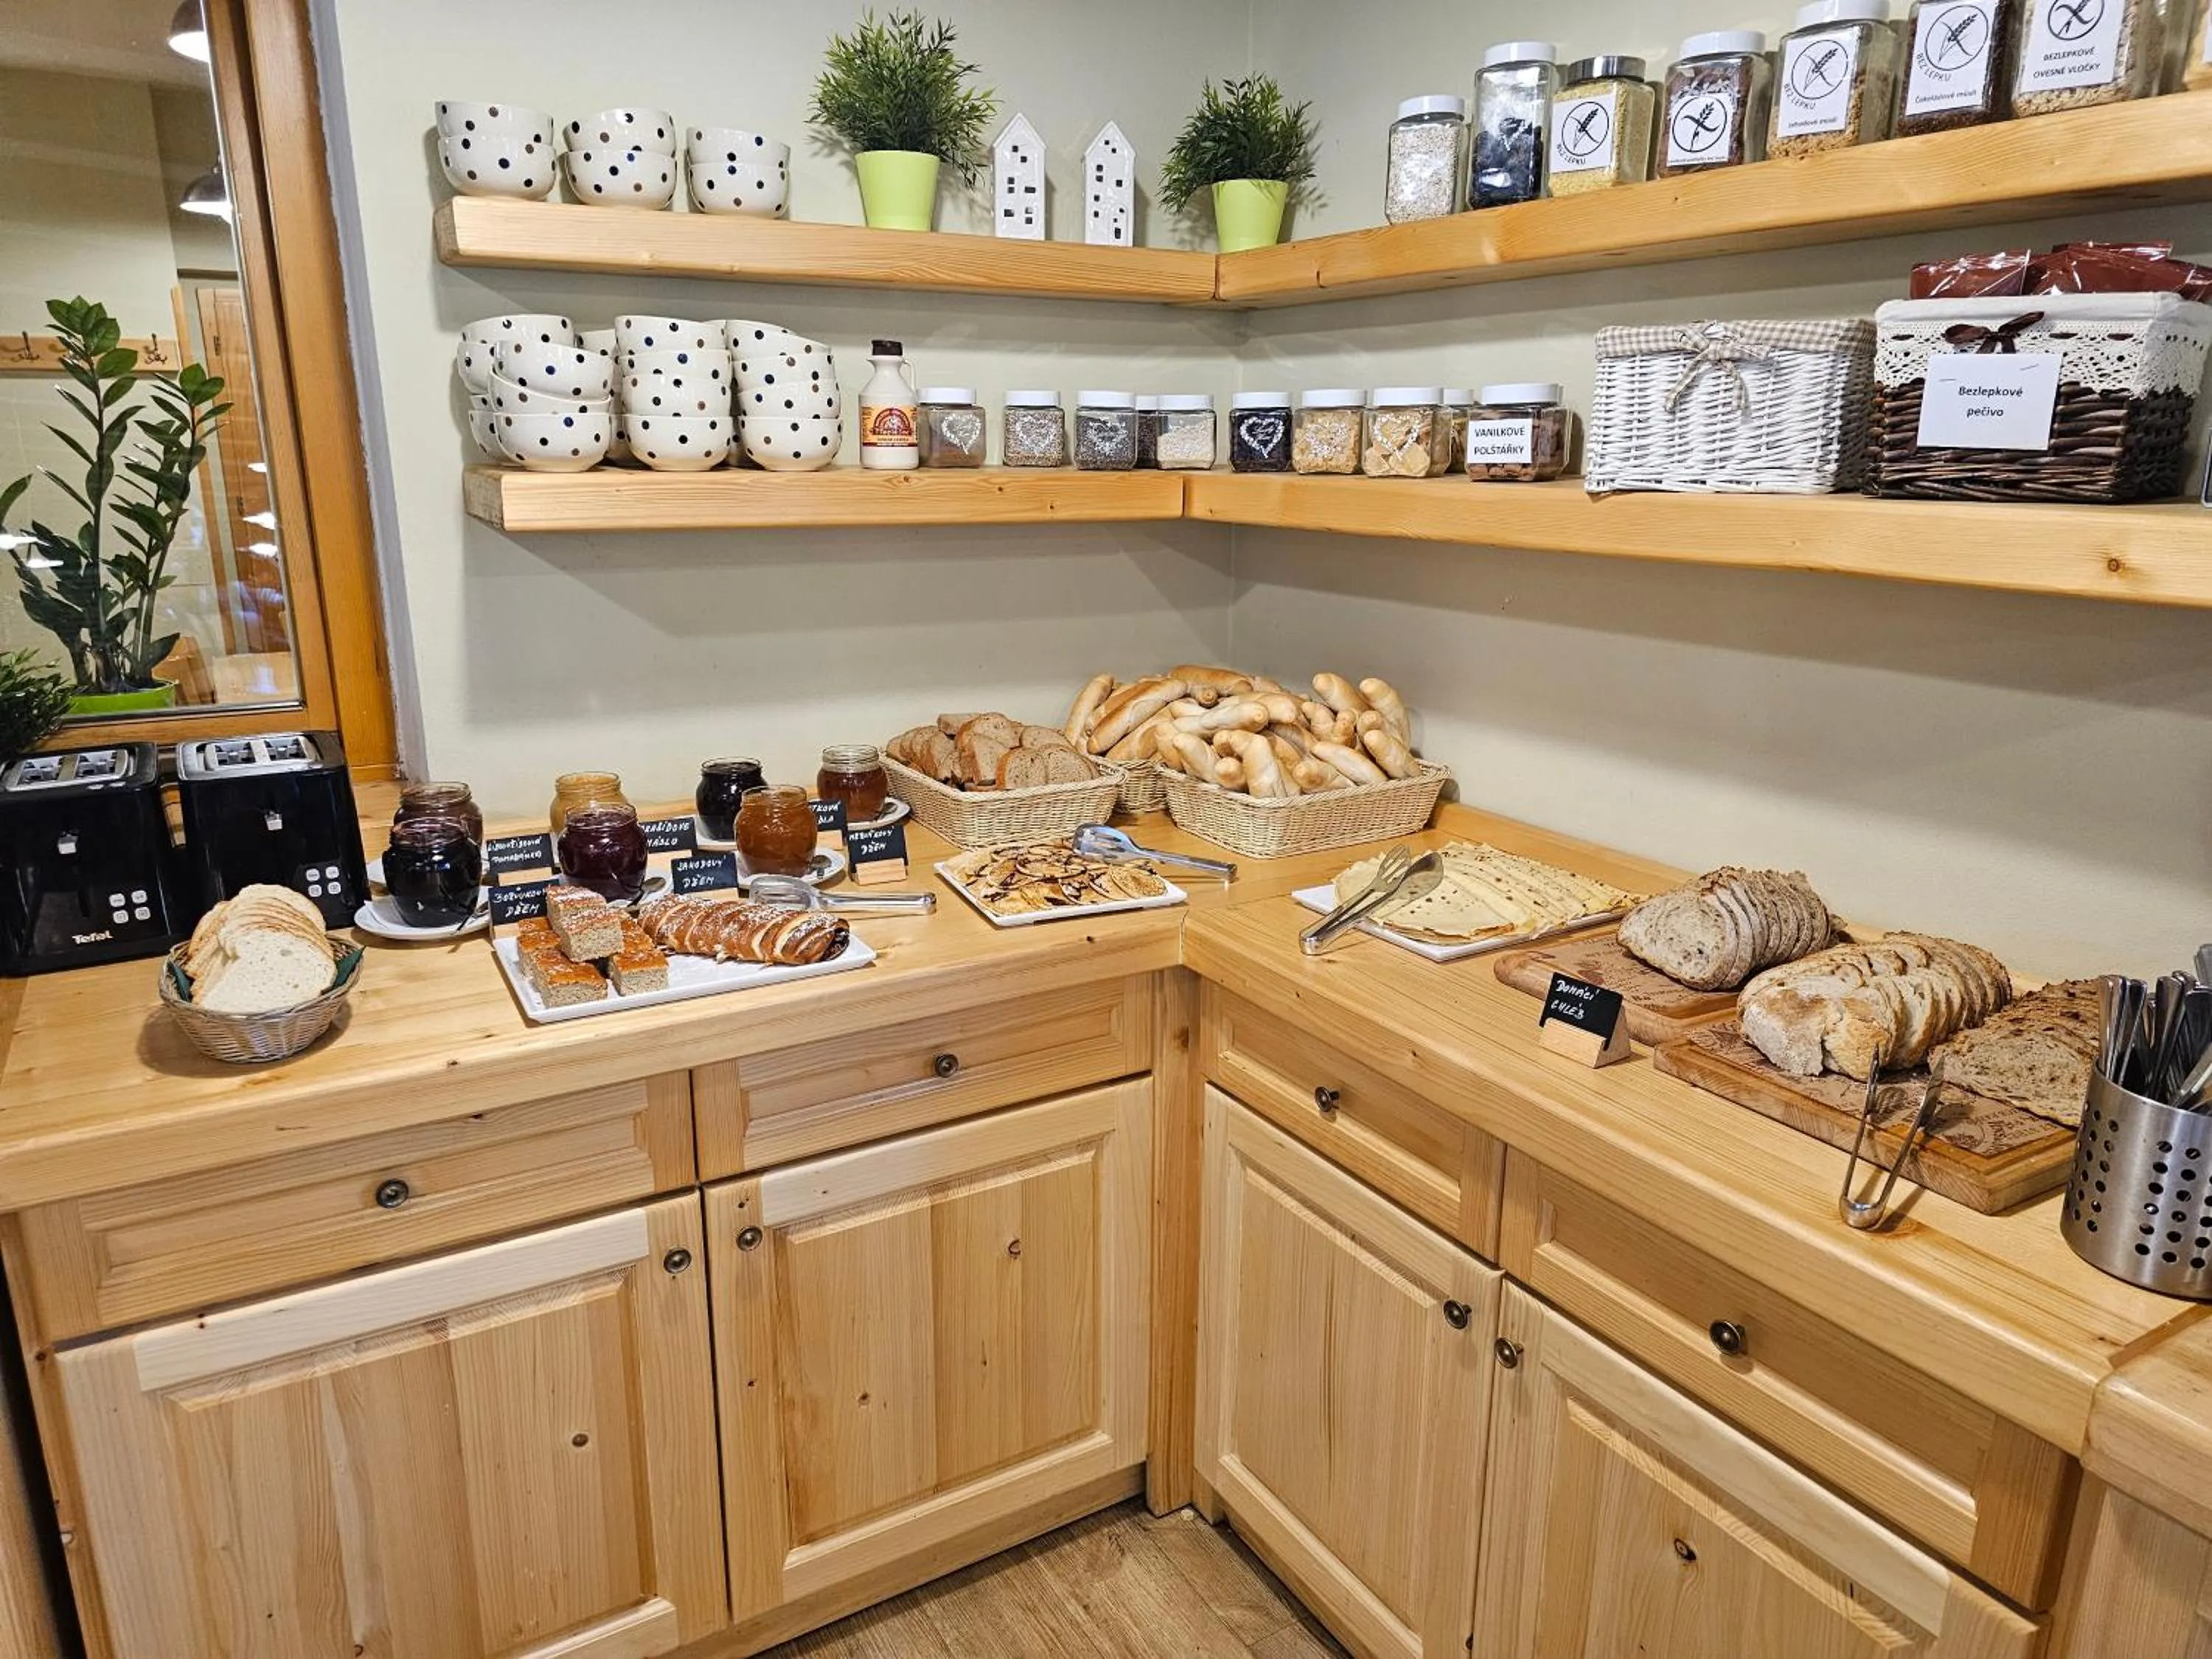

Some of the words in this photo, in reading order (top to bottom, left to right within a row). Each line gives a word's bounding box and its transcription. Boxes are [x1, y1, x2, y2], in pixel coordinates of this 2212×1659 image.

[2043, 46, 2096, 61] BEZLEPKOVÉ
[2033, 67, 2065, 78] OVESNÉ
[2067, 63, 2101, 74] VLOČKY
[1958, 386, 2023, 399] Bezlepkové
[1966, 406, 2004, 418] pečivo
[1474, 425, 1526, 437] VANILKOVÉ
[860, 841, 887, 855] DŽEM
[682, 874, 714, 888] DŽEM
[505, 901, 540, 918] DŽEM
[72, 931, 114, 945] Tefal
[1551, 999, 1585, 1020] CHLÉB
